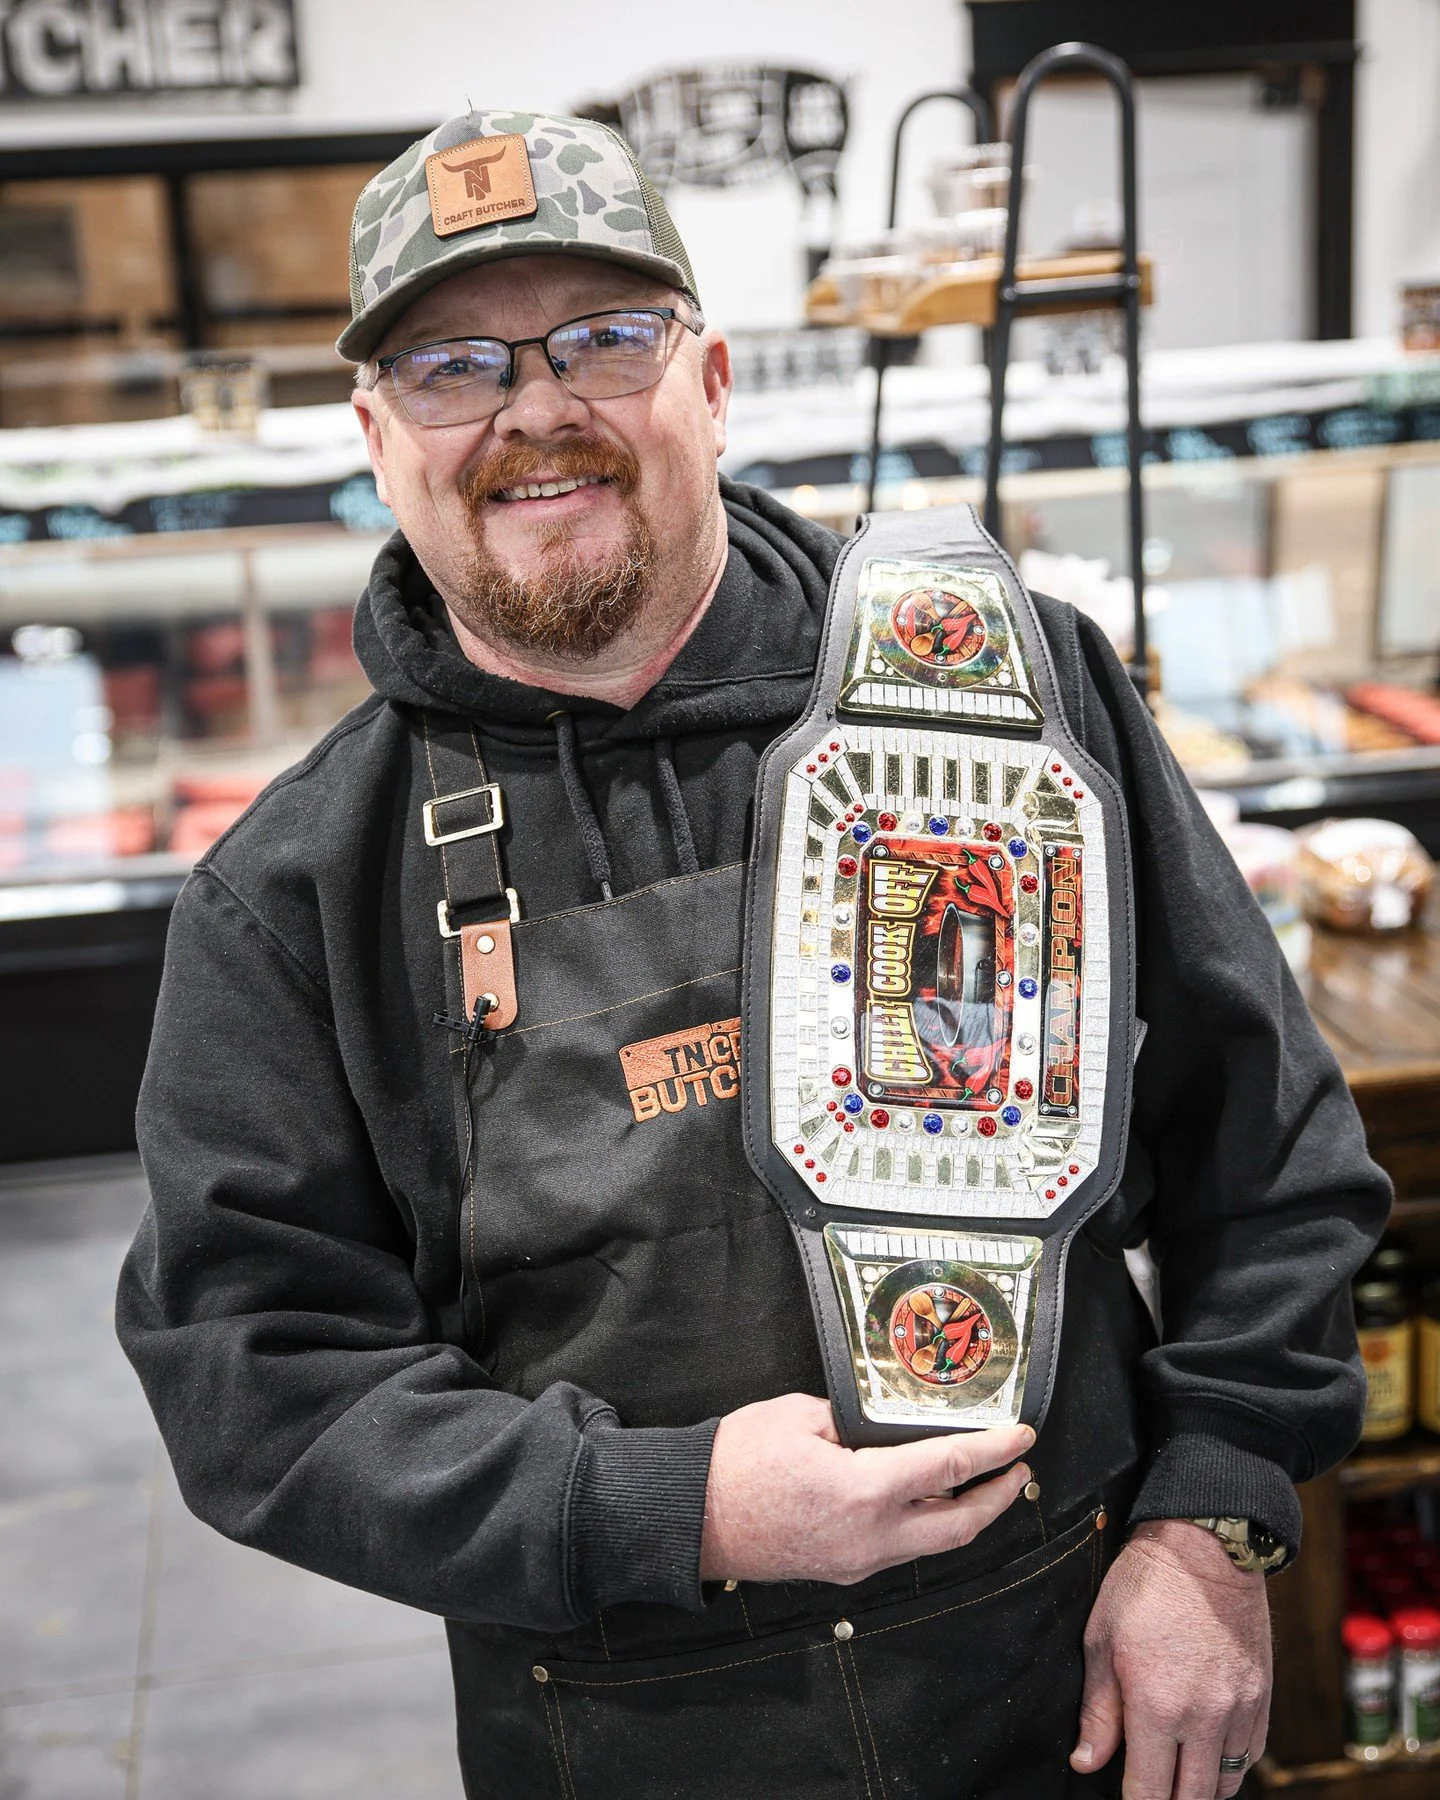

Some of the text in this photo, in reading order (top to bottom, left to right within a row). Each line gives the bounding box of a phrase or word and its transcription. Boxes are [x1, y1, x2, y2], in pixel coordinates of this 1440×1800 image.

[0, 0, 291, 94] CHER
[443, 198, 526, 226] CRAFT BUTCHER
[866, 860, 937, 1083] CHILI COOK OFF
[1048, 857, 1078, 1106] CHAMPION
[629, 1062, 742, 1124] BUTC
